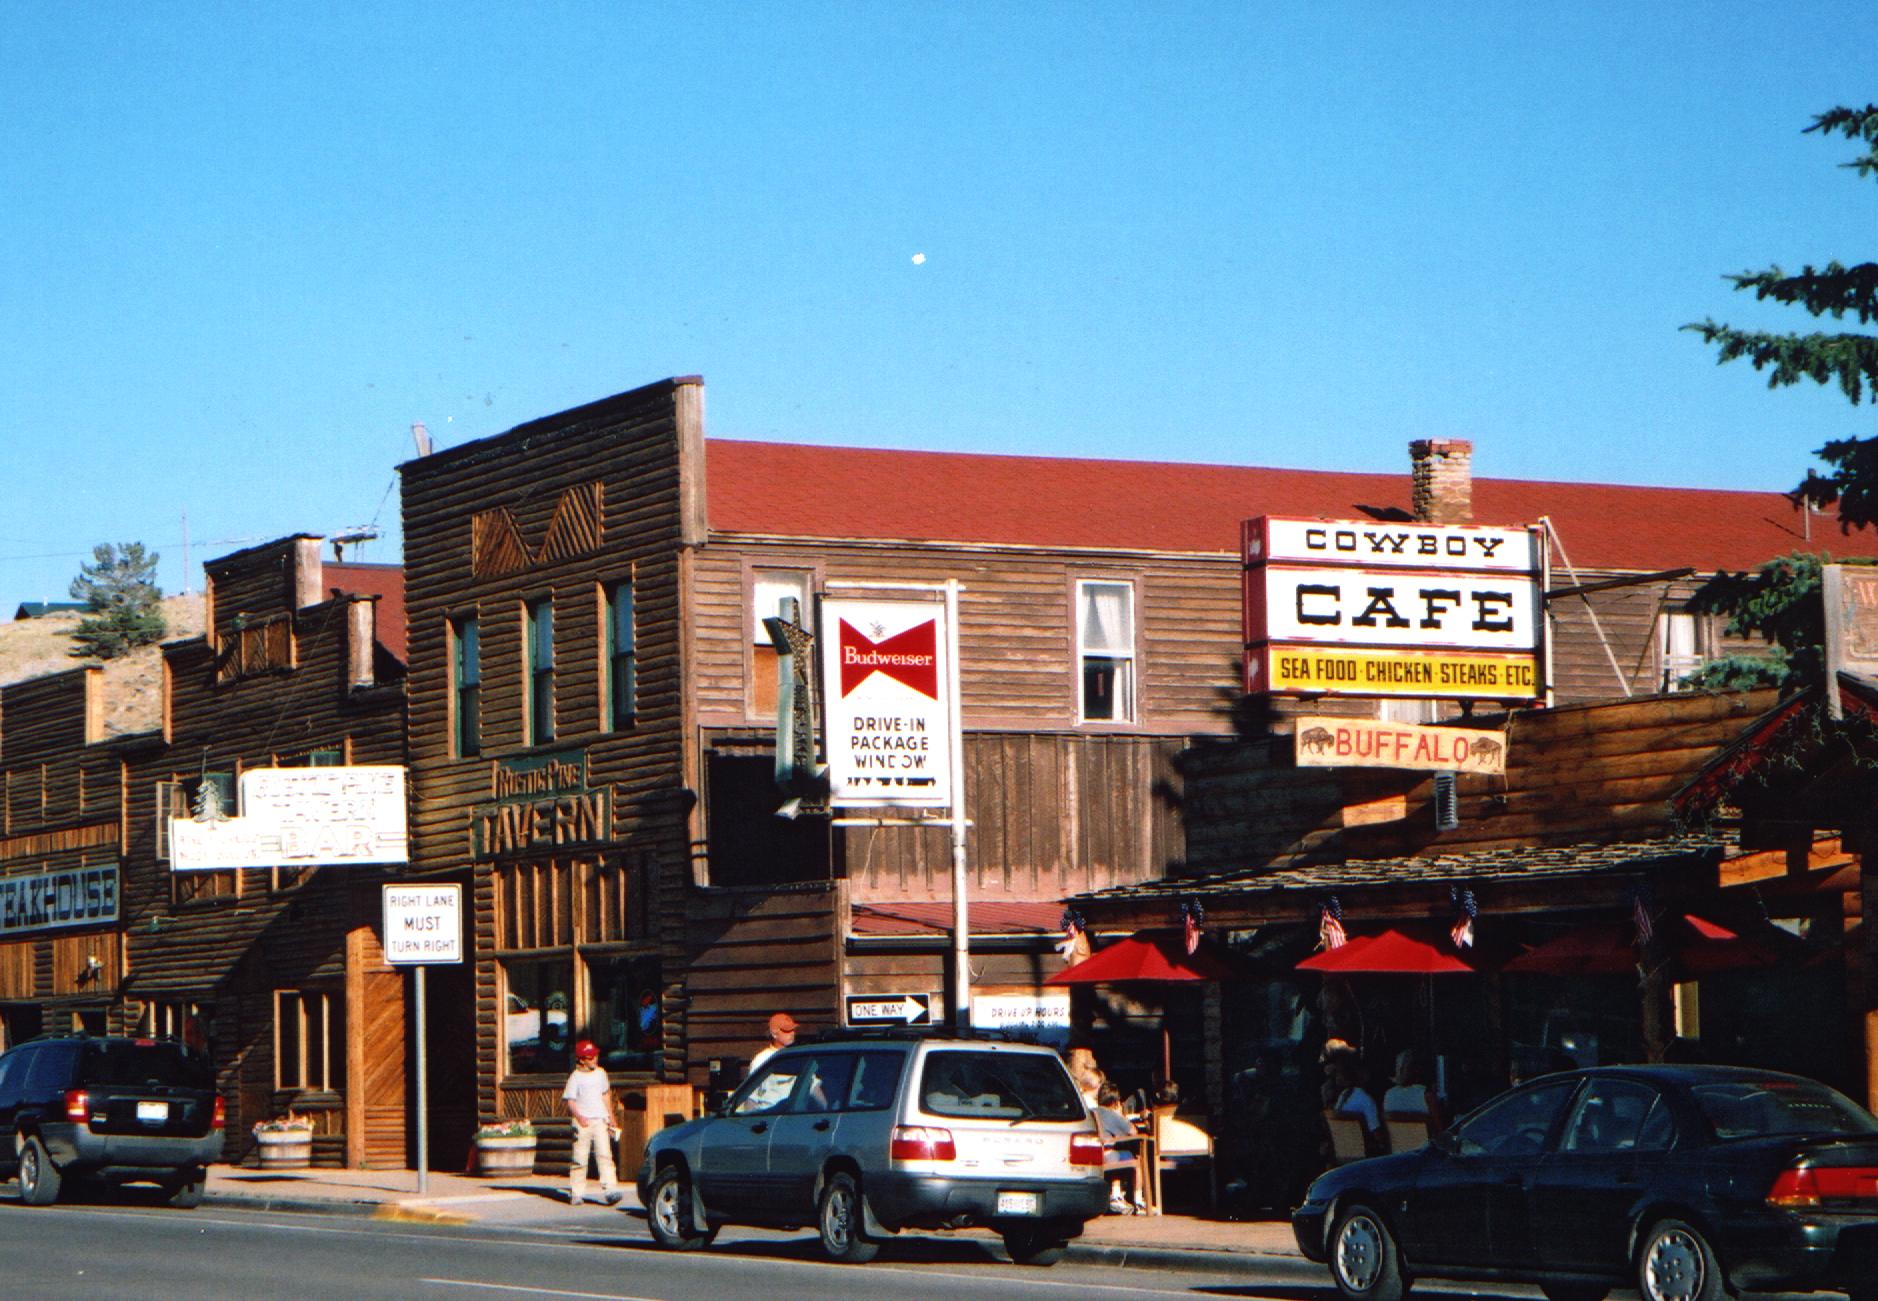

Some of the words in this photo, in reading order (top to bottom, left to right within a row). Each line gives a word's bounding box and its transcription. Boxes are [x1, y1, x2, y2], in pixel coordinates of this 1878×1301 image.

[1305, 528, 1504, 558] COWBOY
[1295, 583, 1514, 632] CAFE
[843, 645, 933, 667] Budweiser
[1281, 657, 1311, 680] SEA
[1316, 659, 1357, 682] FOOD
[1365, 661, 1433, 684] CHICKEN
[1440, 662, 1498, 686] STEAKS
[853, 716, 926, 732] DRIVE-IN
[851, 735, 929, 751] PACKAGE
[1335, 728, 1470, 764] BUFFALO
[472, 793, 605, 854] TAVERN
[0, 869, 116, 930] EAKHOUSE
[389, 895, 421, 908] RIGHT
[425, 895, 455, 907] LANE
[403, 916, 441, 931] MUST
[391, 940, 420, 953] TURN
[423, 939, 456, 952] RIGHT
[854, 1004, 879, 1017] ONE
[881, 1003, 904, 1016] WAY
